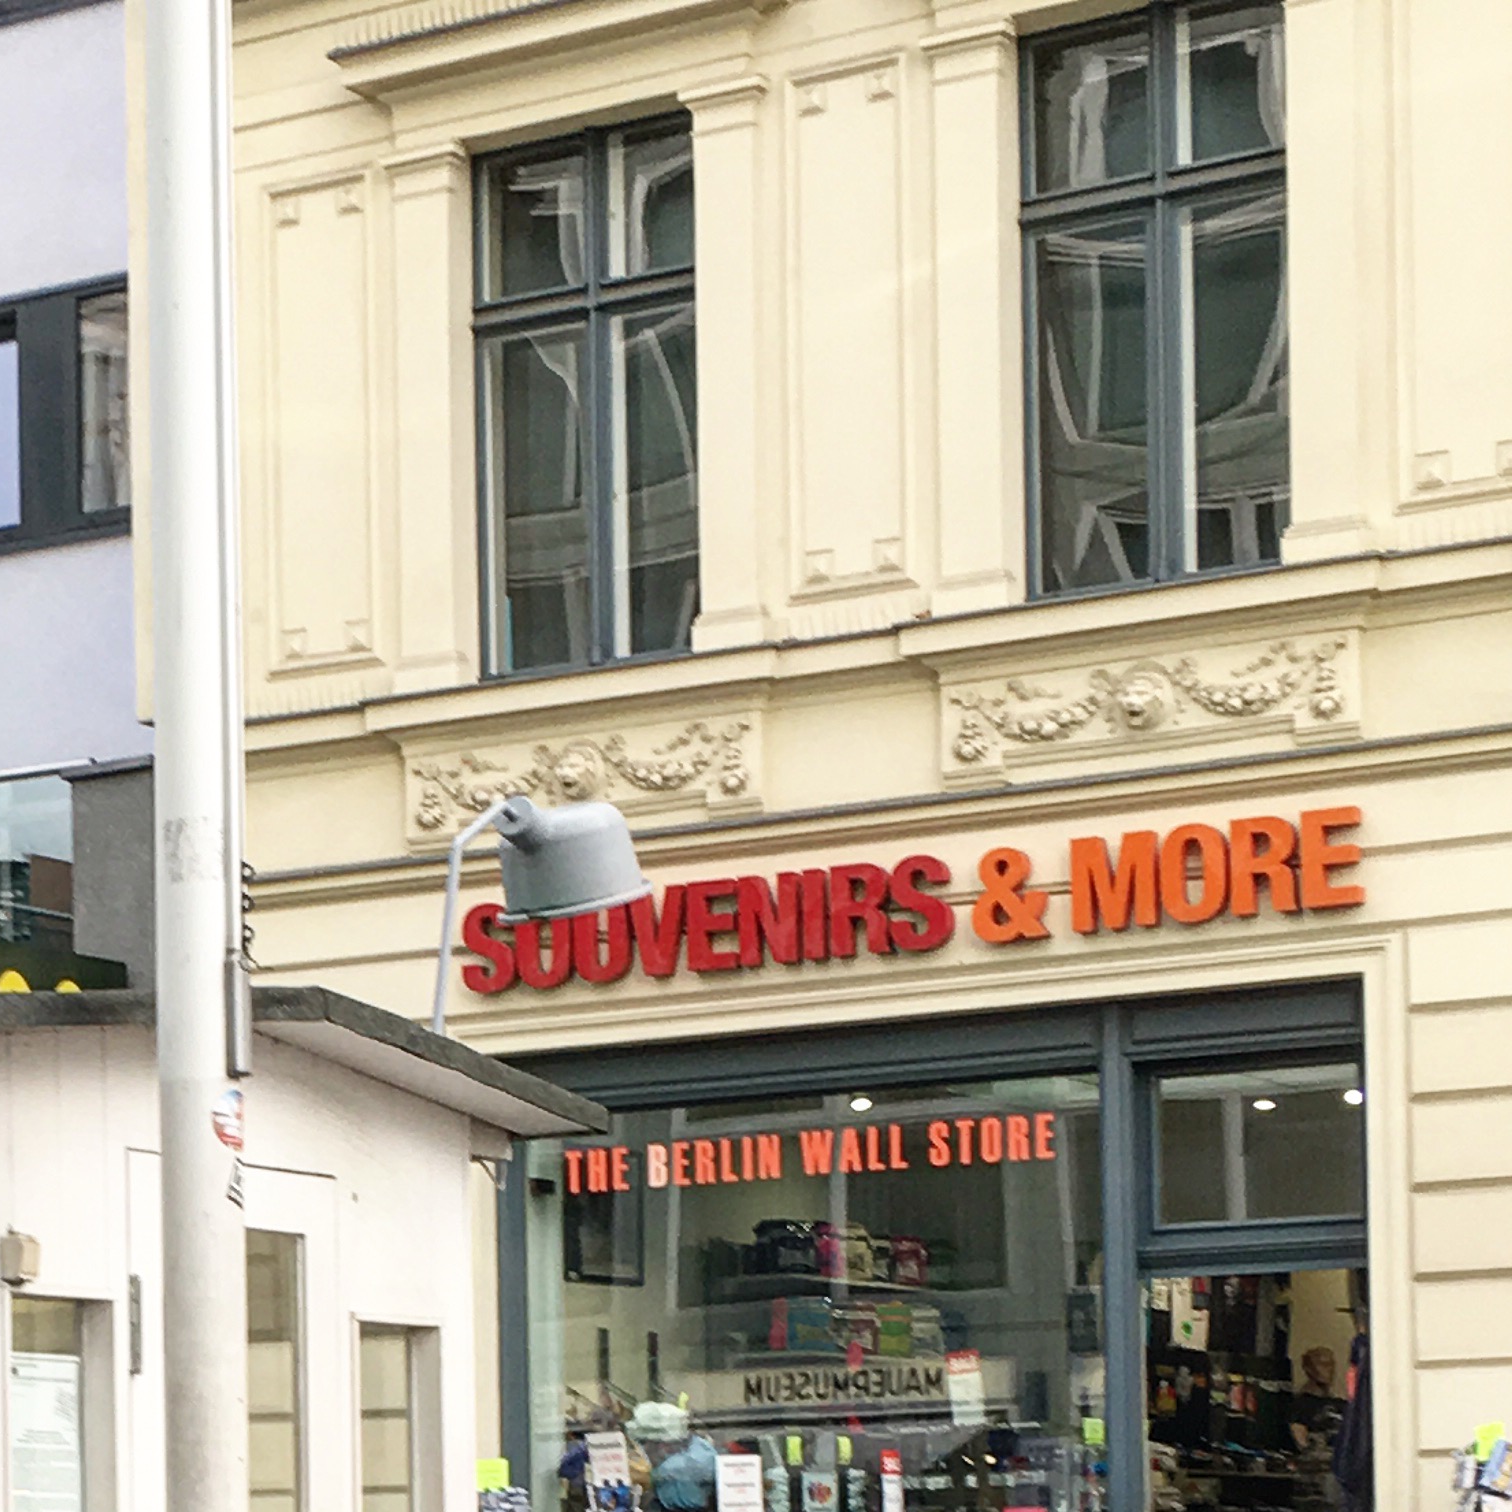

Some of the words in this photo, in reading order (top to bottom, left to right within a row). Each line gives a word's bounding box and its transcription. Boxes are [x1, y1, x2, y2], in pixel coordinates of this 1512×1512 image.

[462, 854, 954, 995] SOUVENIRS
[972, 847, 1051, 943] &
[1069, 806, 1366, 935] MORE
[564, 1145, 630, 1193] THE
[646, 1133, 782, 1189] BERLIN
[800, 1123, 909, 1176] WALL
[928, 1112, 1056, 1168] STORE
